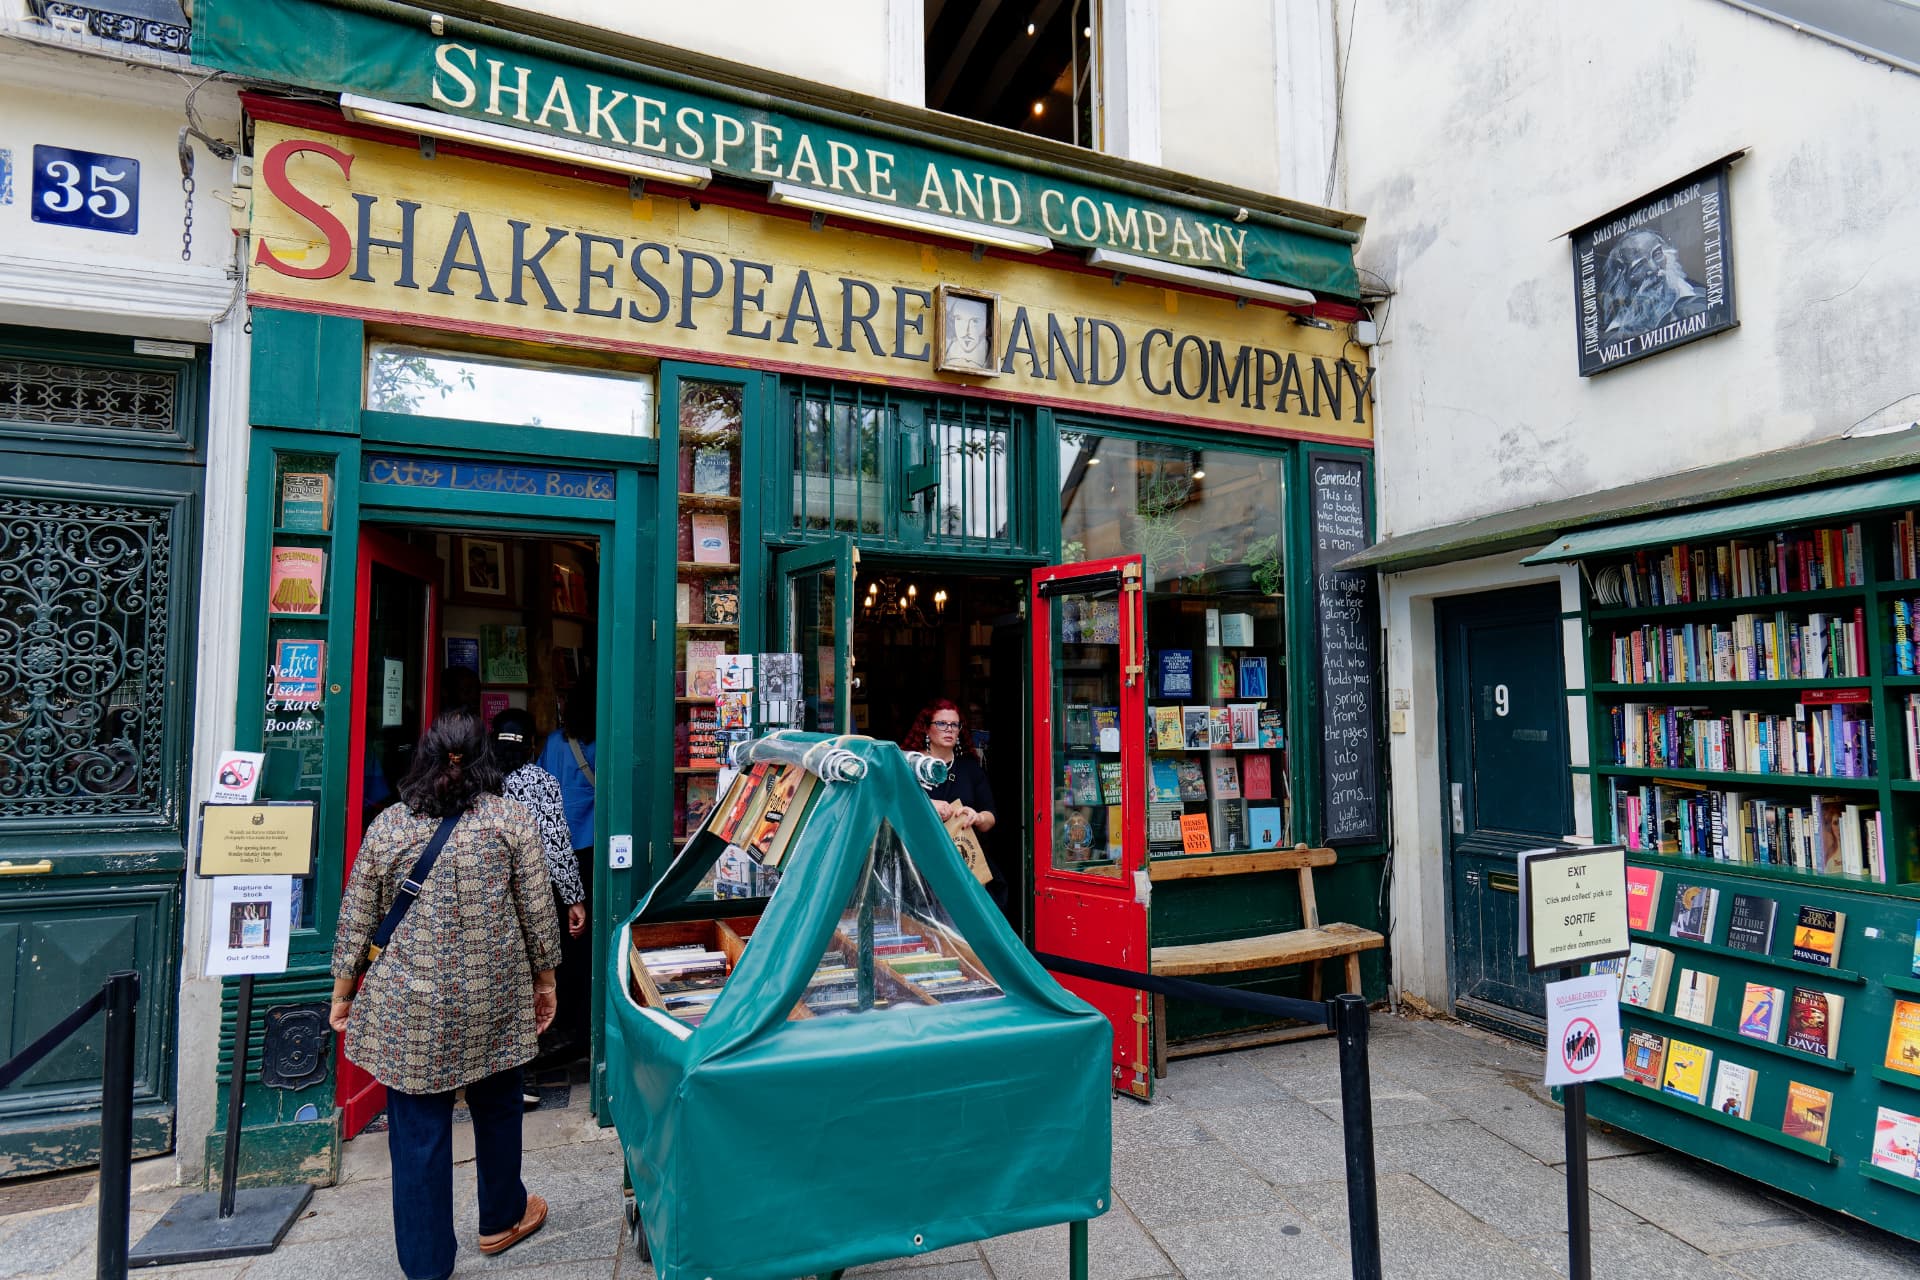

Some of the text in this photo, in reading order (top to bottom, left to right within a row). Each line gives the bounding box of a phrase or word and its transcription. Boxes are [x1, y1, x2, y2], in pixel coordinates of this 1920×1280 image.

[433, 42, 1247, 272] SHAKESPEARE AND COMPANY
[43, 160, 130, 219] 35
[1593, 183, 1701, 246] SAIS PAS AVEC QUEL DESIR
[256, 139, 1377, 425] SHAKESPEARE AND COMPANY
[1584, 297, 1597, 314] QUI
[1599, 311, 1707, 364] WALT WHITMAN
[369, 459, 443, 486] City
[450, 465, 538, 495] Lights
[1315, 466, 1361, 487] Camerado!
[1320, 488, 1353, 501] This is
[1323, 502, 1334, 511] no
[1334, 511, 1363, 525] touches
[1319, 538, 1327, 550] a
[1331, 575, 1339, 591] it
[1341, 576, 1366, 600] night?
[1319, 593, 1364, 608] Are we here
[1325, 606, 1361, 624] alone?)
[1322, 622, 1355, 639] It is I
[1326, 640, 1341, 654] you
[1323, 653, 1366, 669] And who
[267, 664, 304, 680] New,
[1328, 670, 1351, 687] holds
[266, 682, 305, 696] Used
[265, 697, 320, 711] & Rare
[1325, 690, 1367, 713] I spring
[1495, 684, 1509, 717] 9
[264, 717, 313, 732] Books
[1333, 706, 1358, 727] from
[1324, 725, 1368, 747] the pages
[1333, 750, 1359, 767] into
[1331, 769, 1359, 791] your
[1338, 808, 1359, 822] Walt
[1186, 841, 1209, 850] WHY
[1567, 865, 1587, 877] EXIT
[1560, 894, 1571, 903] and
[1593, 889, 1604, 899] pick
[1735, 897, 1747, 907] ON
[1563, 912, 1596, 927] SORTIE
[1734, 906, 1750, 917] THE
[1732, 916, 1765, 930] FUTURE
[1728, 940, 1747, 950] REES
[1729, 931, 1758, 944] MARTIN
[1793, 949, 1830, 964] PHANTOM
[1788, 1036, 1827, 1056] DAVIS
